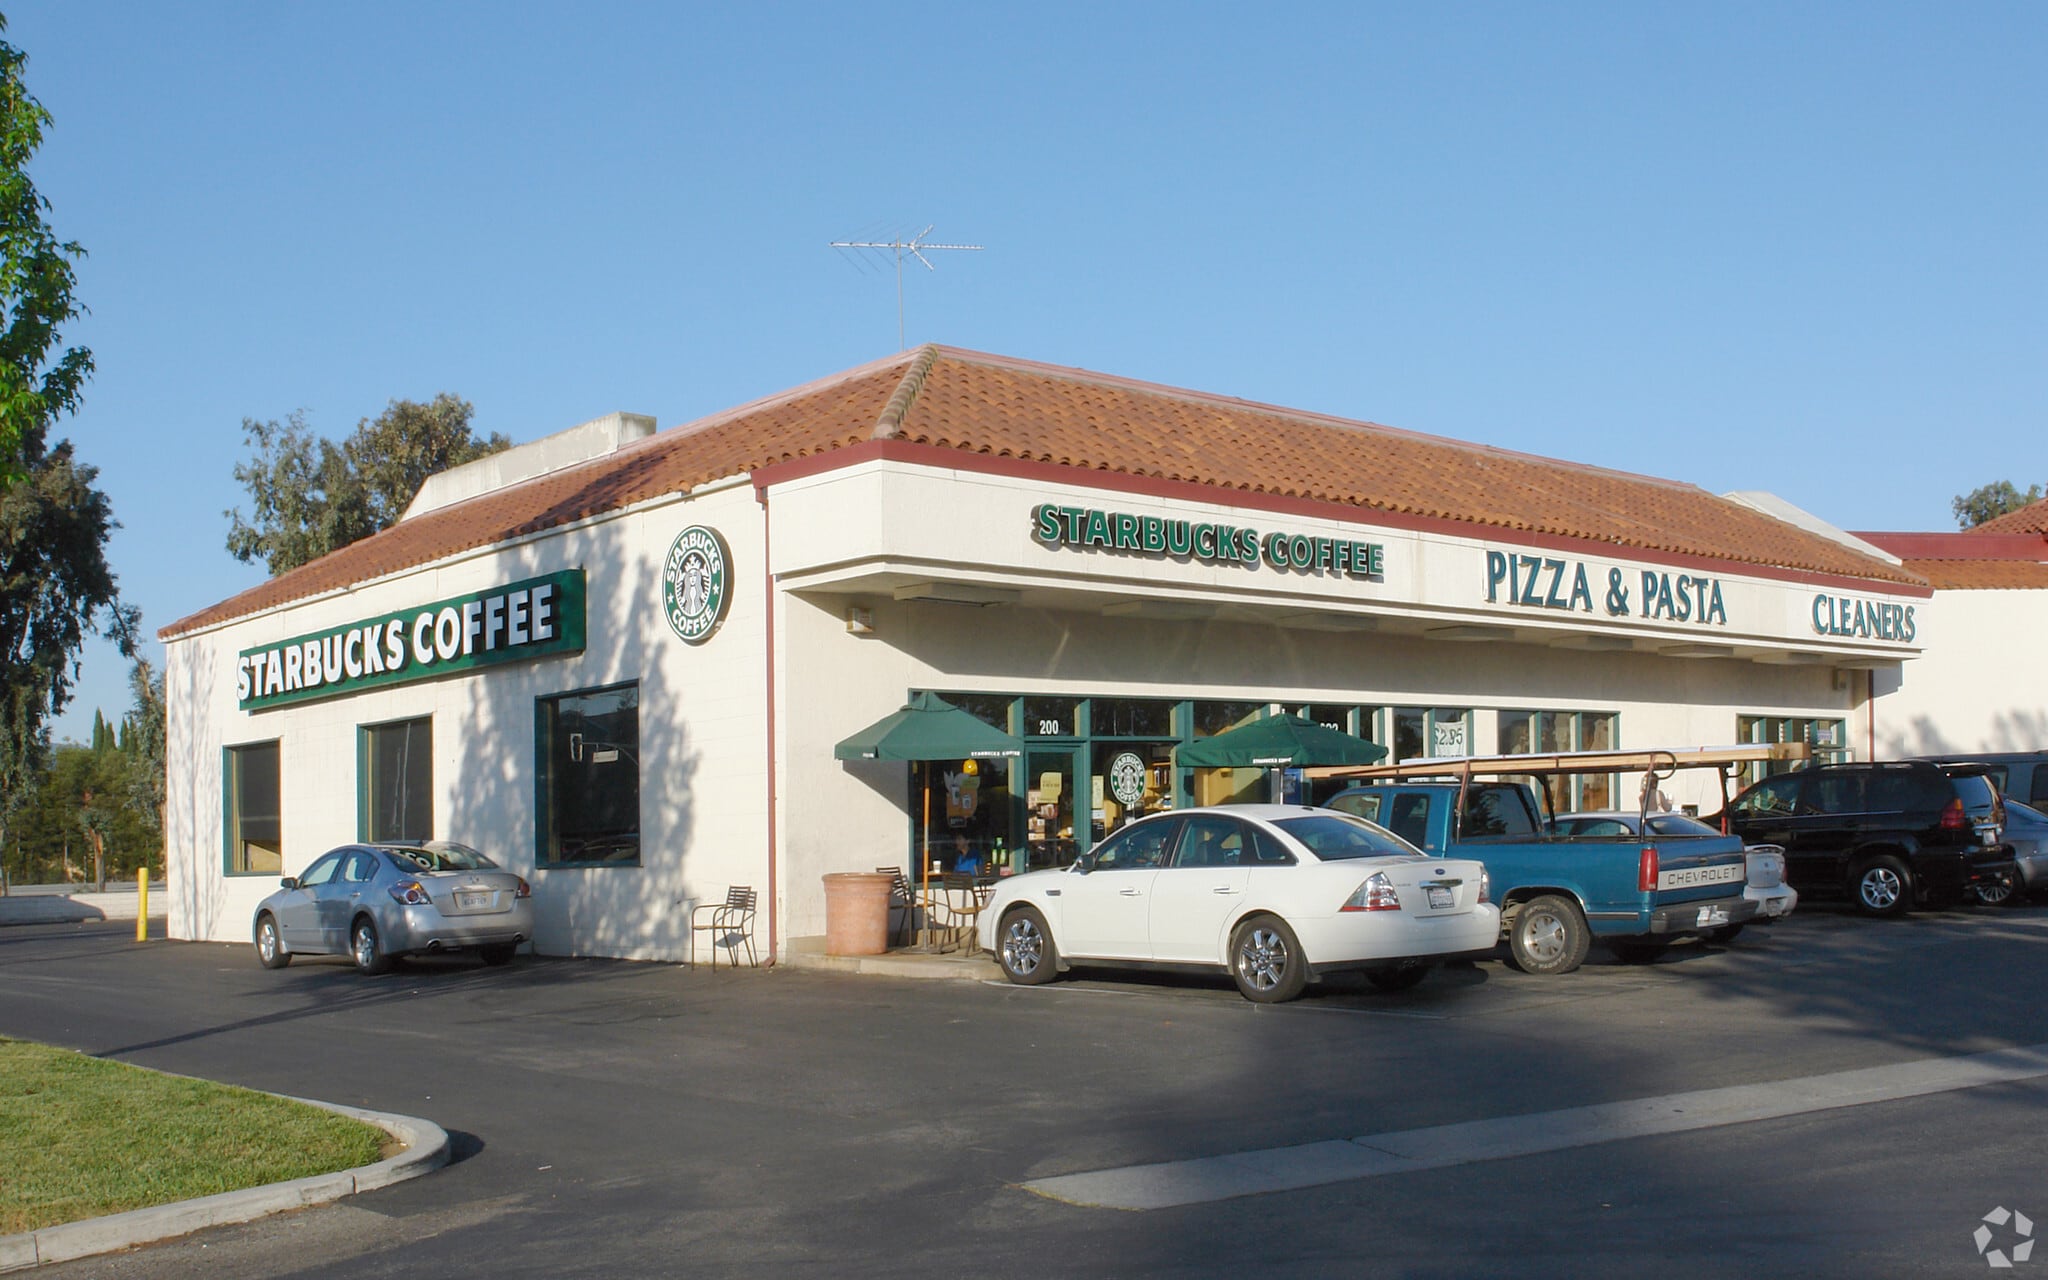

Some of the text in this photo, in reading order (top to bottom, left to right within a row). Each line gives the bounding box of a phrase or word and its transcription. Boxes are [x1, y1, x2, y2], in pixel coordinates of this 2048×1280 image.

[1035, 503, 1385, 576] STARBUCKS COFFEE
[666, 532, 720, 583] STARBUCKS
[1485, 550, 1728, 625] PIZZA & PASTA
[672, 604, 714, 635] COFFEE
[1811, 593, 1917, 644] CLEANERS
[236, 583, 554, 701] STARBUCKS COFFEE
[1039, 719, 1059, 735] 200
[1434, 727, 1464, 746] $2.95
[1112, 755, 1144, 777] STARBUCKS
[1116, 788, 1140, 802] COFFEE
[1668, 867, 1737, 885] CHEVROLET
